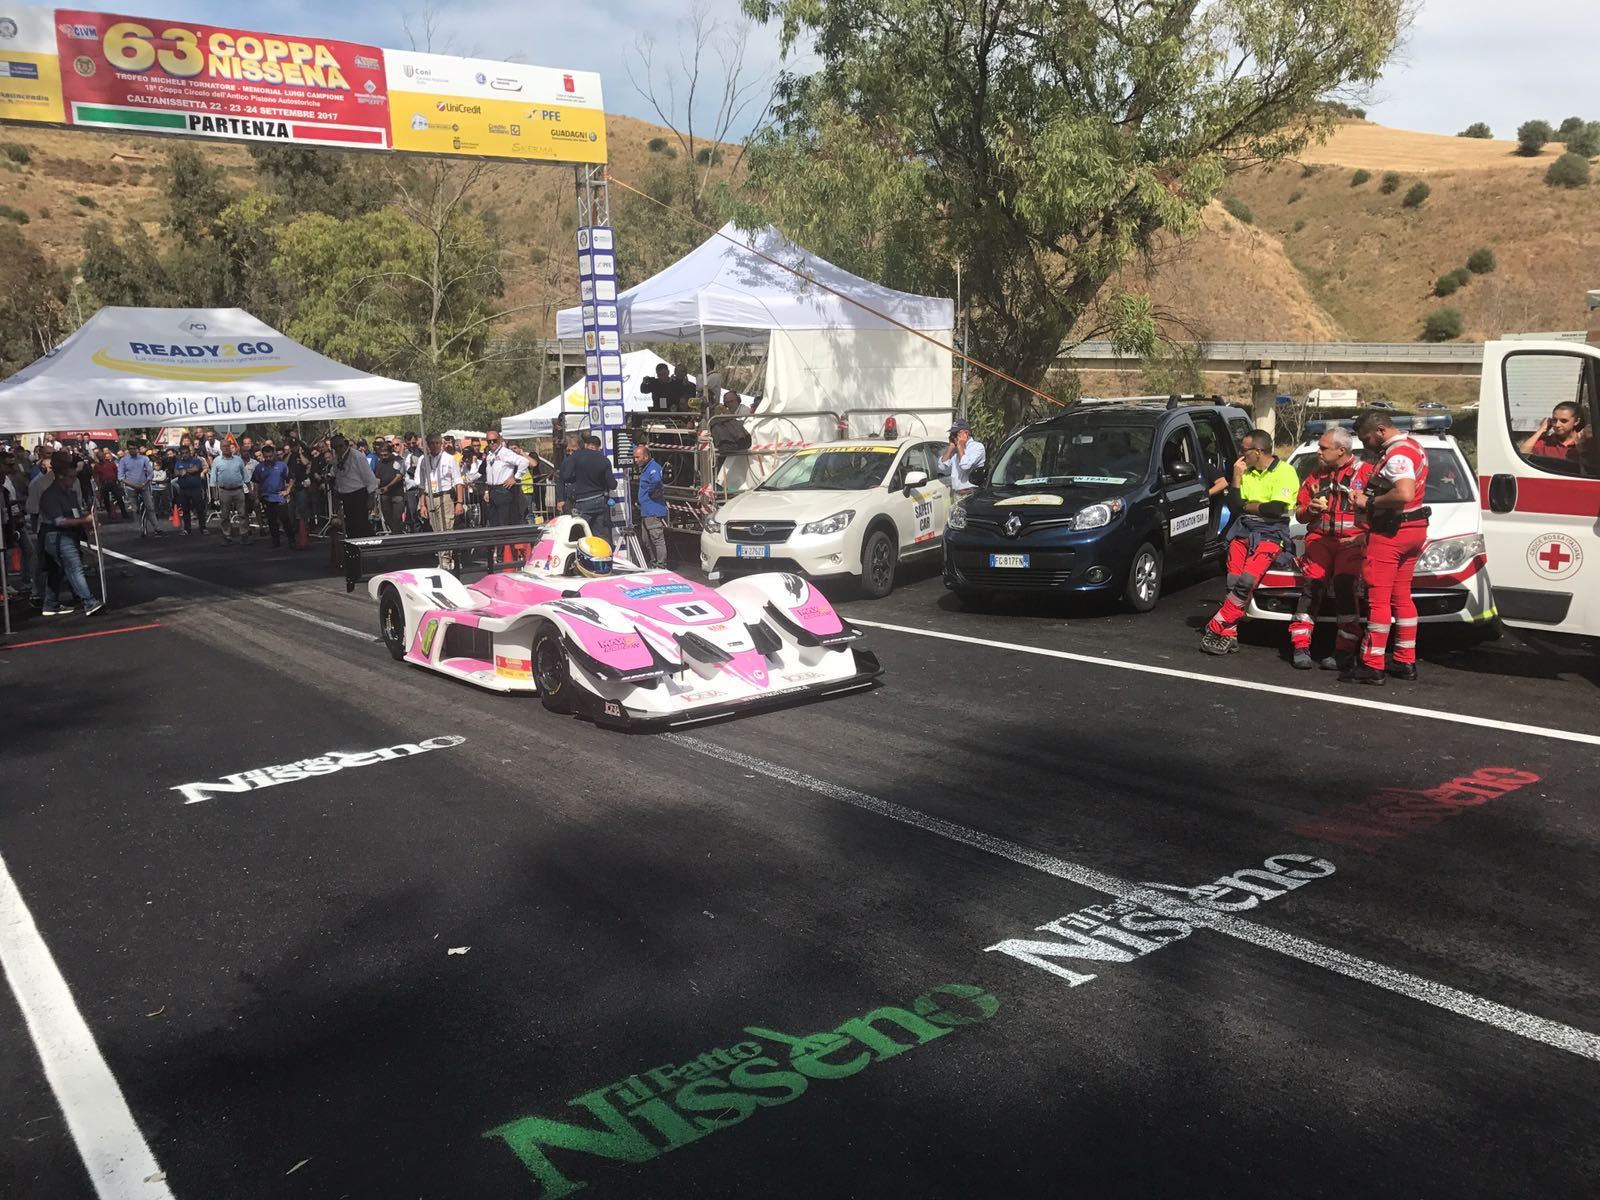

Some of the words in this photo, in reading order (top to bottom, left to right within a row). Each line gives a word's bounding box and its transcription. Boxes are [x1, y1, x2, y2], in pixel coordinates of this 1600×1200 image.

[74, 25, 97, 37] CIVM
[208, 32, 341, 69] COPPA
[208, 53, 351, 91] NISSENA
[415, 68, 431, 76] Coni
[115, 72, 148, 82] TROFEO
[150, 76, 186, 86] MICHELE
[189, 80, 236, 91] TORNATORE
[243, 86, 282, 95] MEMORIAL
[284, 89, 305, 97] LUIGI
[306, 92, 344, 101] CAMPIONE
[158, 85, 182, 95] Coppa
[184, 88, 210, 97] Circolo
[211, 90, 249, 101] dell'Antico
[251, 95, 277, 104] Pistone
[127, 94, 207, 110] CALTANISSETTA
[210, 102, 222, 110] 22
[230, 104, 241, 112] 23
[260, 107, 315, 120] SETTEMBRE
[317, 112, 338, 120] 2017
[446, 103, 481, 114] UniCredit
[542, 110, 561, 121] PFE
[189, 114, 289, 138] PARTENZA
[551, 129, 588, 139] GUADAGNI
[129, 341, 274, 358] READY2GO
[95, 397, 199, 417] Automobile
[204, 396, 242, 415] Club
[246, 392, 346, 413] Caltanissetta
[915, 501, 932, 519] SAFETY
[920, 516, 930, 532] CAR
[1530, 539, 1543, 557] CROCE
[1543, 534, 1565, 542] ROSSA
[170, 735, 466, 805] Nisseno
[643, 1041, 763, 1093] Fatto
[480, 983, 999, 1200] Nisseno
